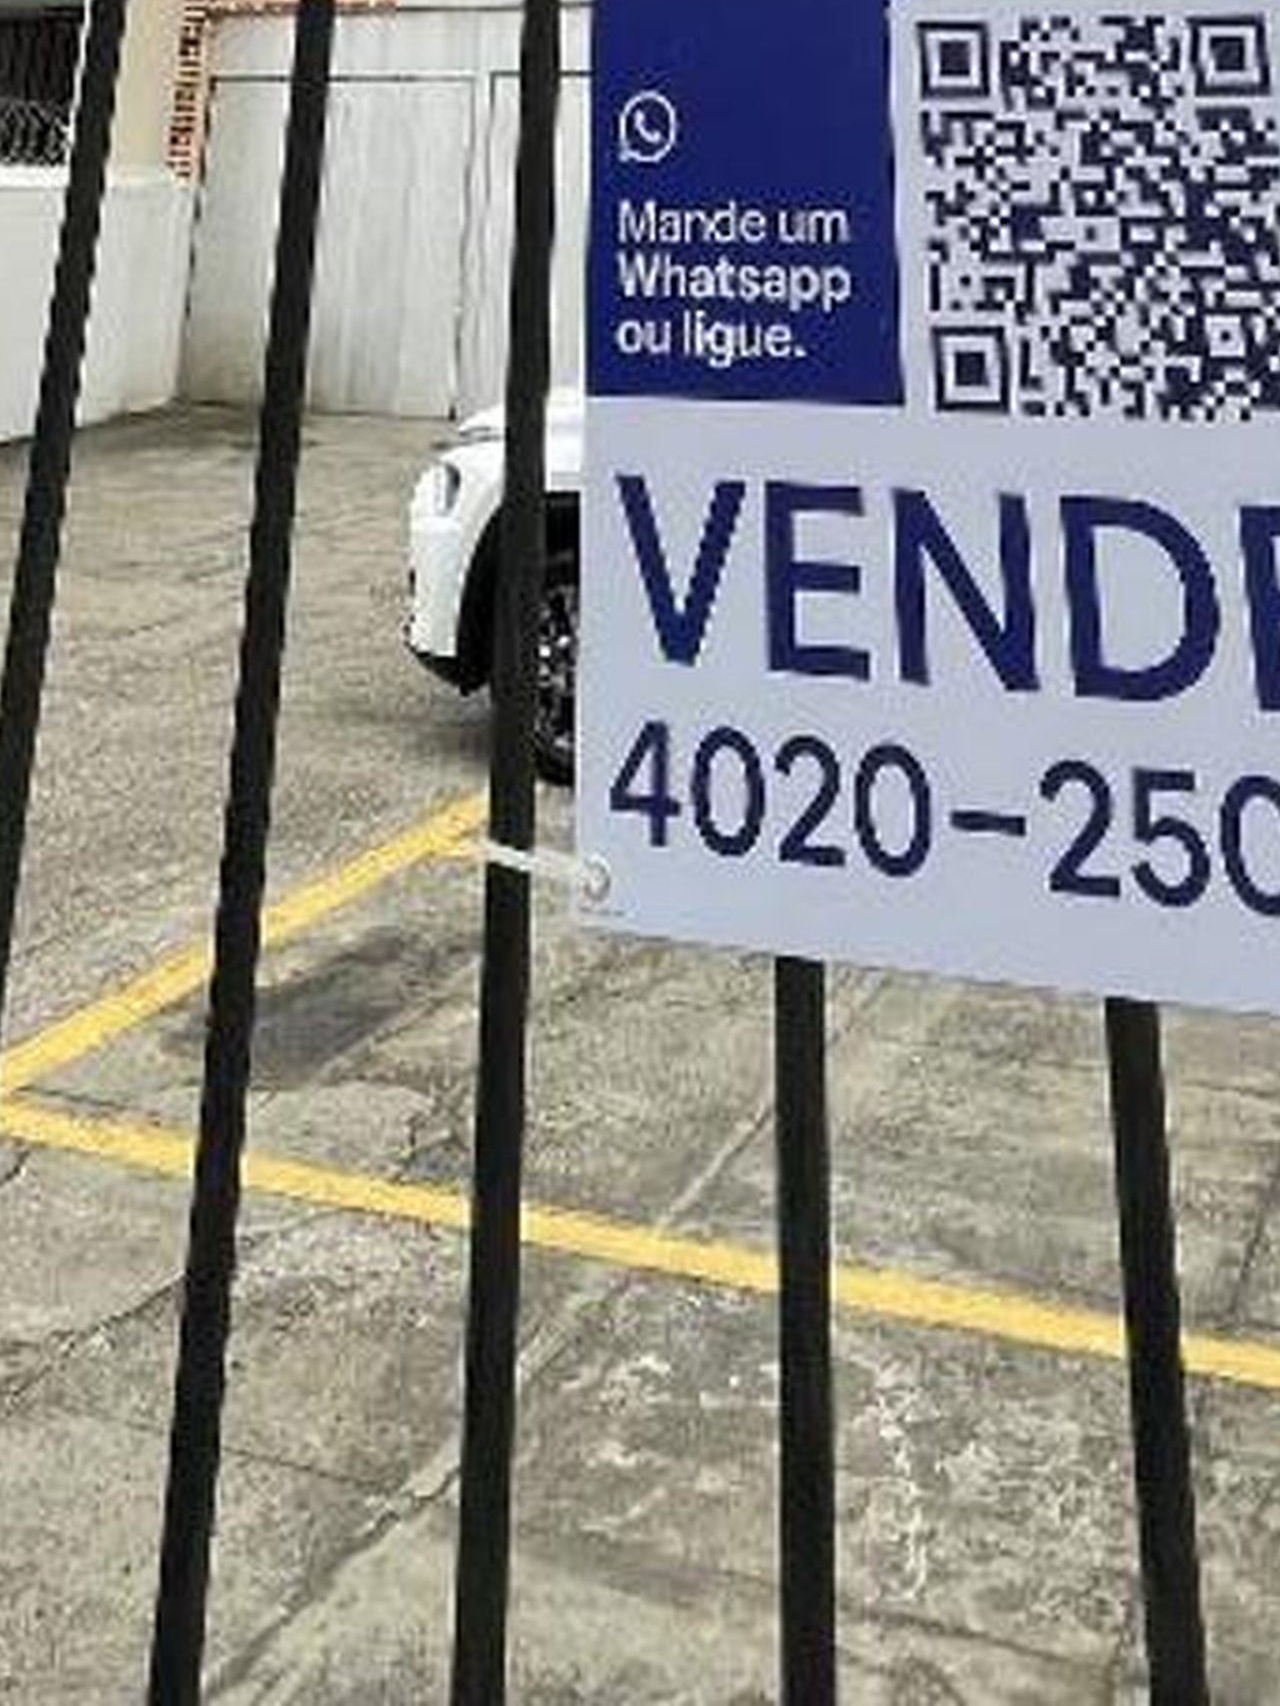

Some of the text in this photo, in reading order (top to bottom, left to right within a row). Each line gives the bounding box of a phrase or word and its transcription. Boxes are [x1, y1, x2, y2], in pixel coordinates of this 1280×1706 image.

[618, 199, 851, 244] Mande um
[617, 252, 852, 313] Whatsapp
[617, 309, 808, 369] ou ligue.
